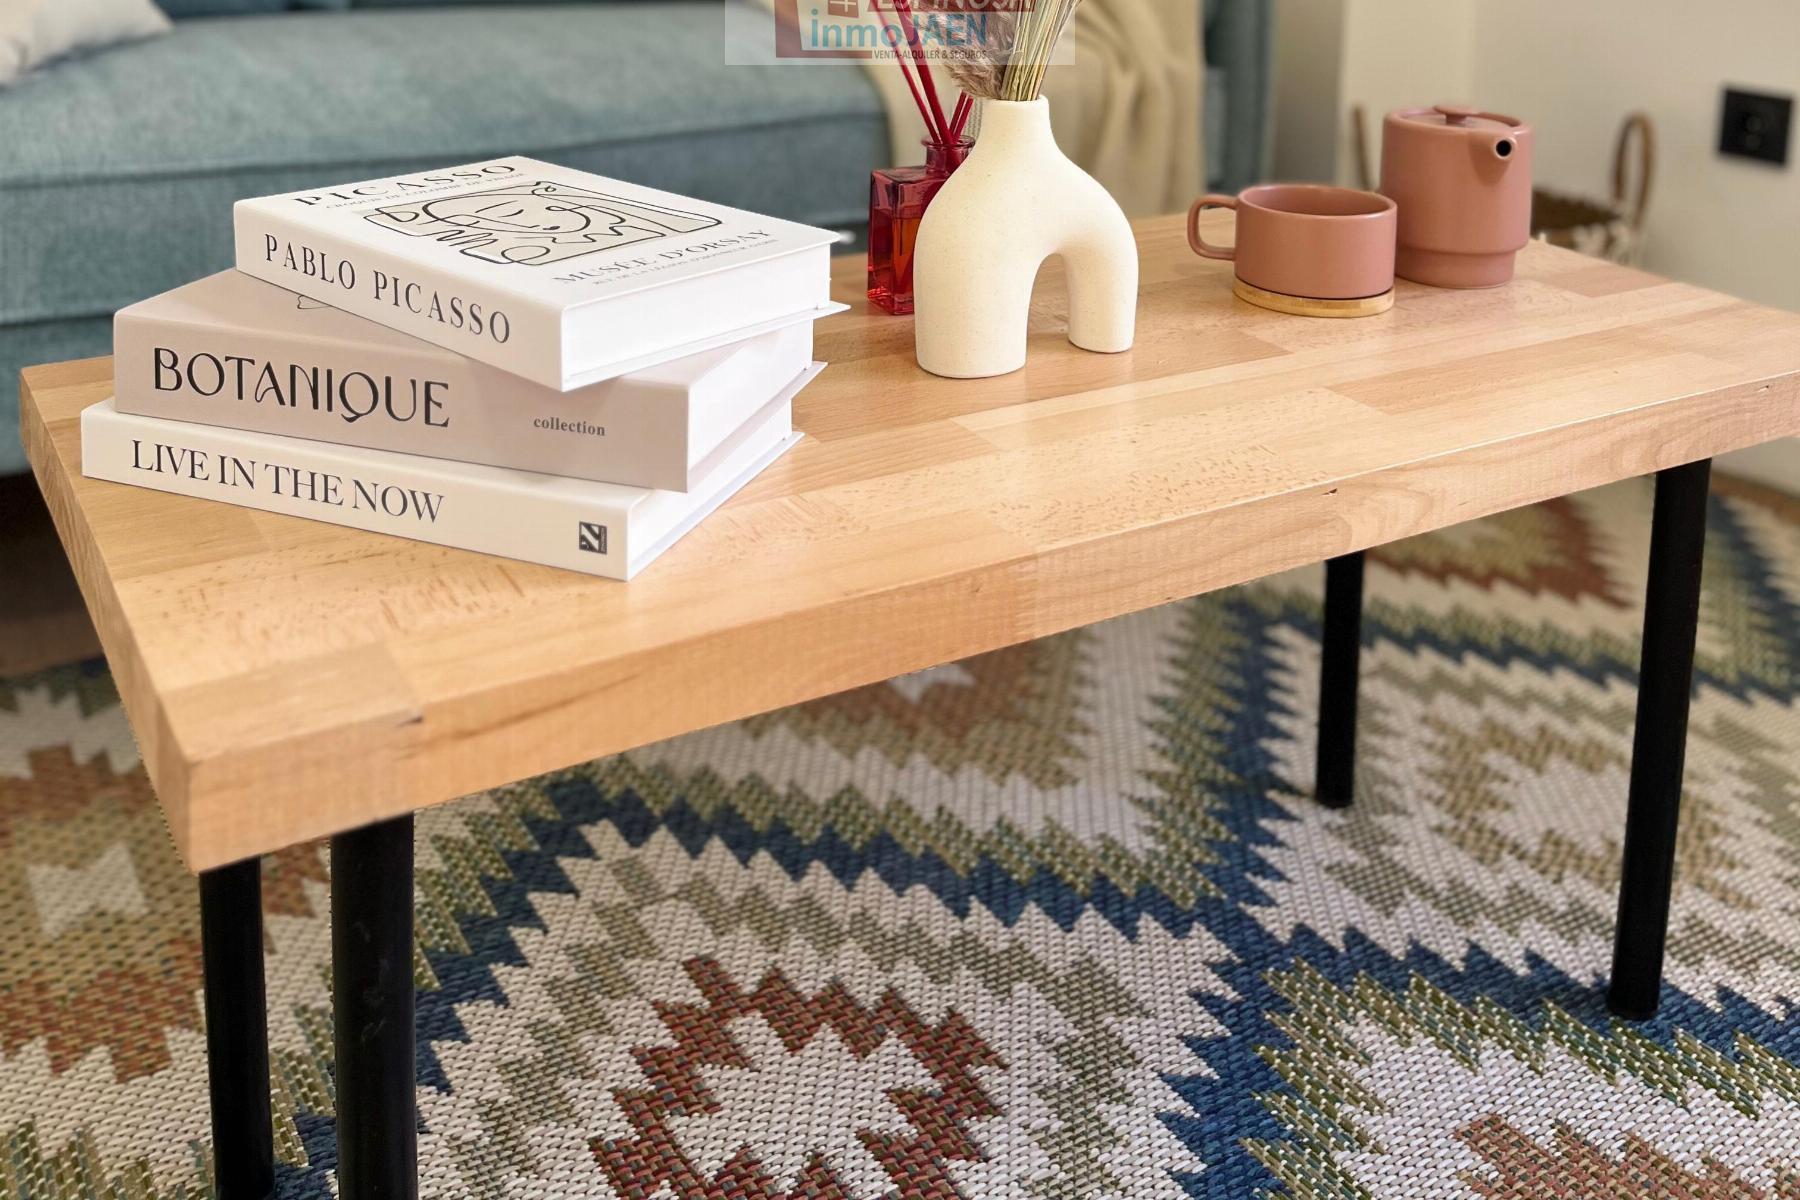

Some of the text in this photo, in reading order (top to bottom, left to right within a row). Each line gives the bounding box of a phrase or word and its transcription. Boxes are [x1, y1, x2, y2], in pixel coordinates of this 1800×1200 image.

[293, 165, 515, 205] PICASSO
[264, 233, 510, 344] PABLO PICASSO
[552, 256, 657, 285] MUSÉE
[153, 347, 450, 428] BOTANIQUE
[533, 417, 606, 436] collection
[131, 439, 444, 523] LIVE IN THE NOW
